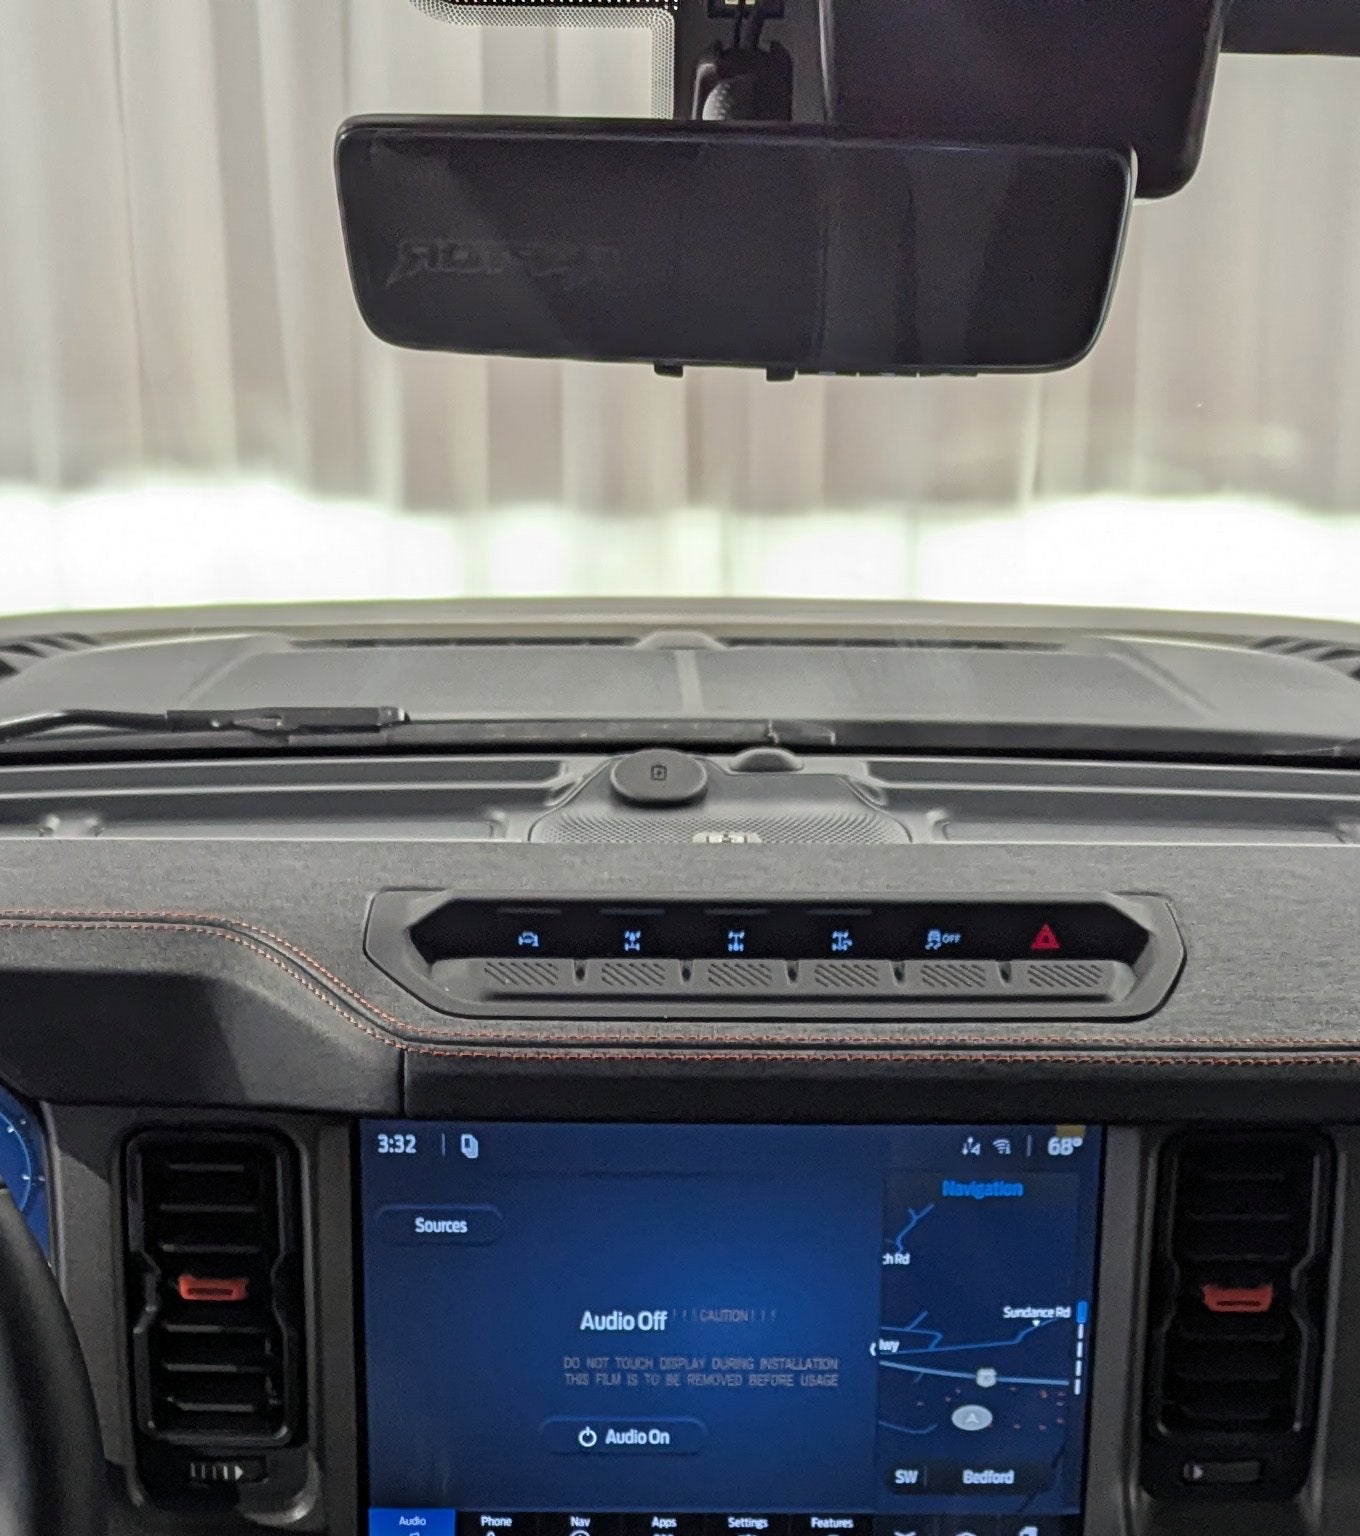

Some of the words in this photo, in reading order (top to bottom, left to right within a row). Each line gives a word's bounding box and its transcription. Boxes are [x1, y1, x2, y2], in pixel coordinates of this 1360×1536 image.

[942, 932, 962, 945] OFF
[377, 1134, 417, 1154] 3:32
[942, 1180, 1024, 1198] Navigation
[414, 1216, 468, 1234] Sources
[894, 1253, 911, 1265] Rd
[699, 1309, 749, 1322] CAUTION
[1003, 1307, 1054, 1319] Sundance
[1055, 1306, 1072, 1319] Rd
[580, 1310, 635, 1331] Audio
[638, 1310, 668, 1331] Off
[563, 1356, 580, 1370] DO
[587, 1357, 609, 1370] NOT
[615, 1357, 653, 1370] TOUCH
[660, 1357, 705, 1370] DISPLAY
[712, 1357, 754, 1370] DURING
[760, 1357, 839, 1371] INSTALLATION
[564, 1373, 589, 1386] THIS
[596, 1373, 621, 1386] FILM
[627, 1373, 638, 1386] IS
[665, 1373, 681, 1386] BE
[687, 1373, 743, 1387] REMOVED
[749, 1373, 794, 1387] BEFORE
[800, 1373, 839, 1387] USAGE
[605, 1429, 647, 1445] Audio
[649, 1429, 670, 1445] On
[895, 1469, 918, 1484] SW
[962, 1469, 1015, 1484] Bedford
[399, 1516, 427, 1527] Audio
[480, 1516, 512, 1527] Phone
[571, 1516, 591, 1527] Nav
[651, 1516, 677, 1529] Apps
[728, 1516, 768, 1529] Settings
[811, 1517, 854, 1528] Features
